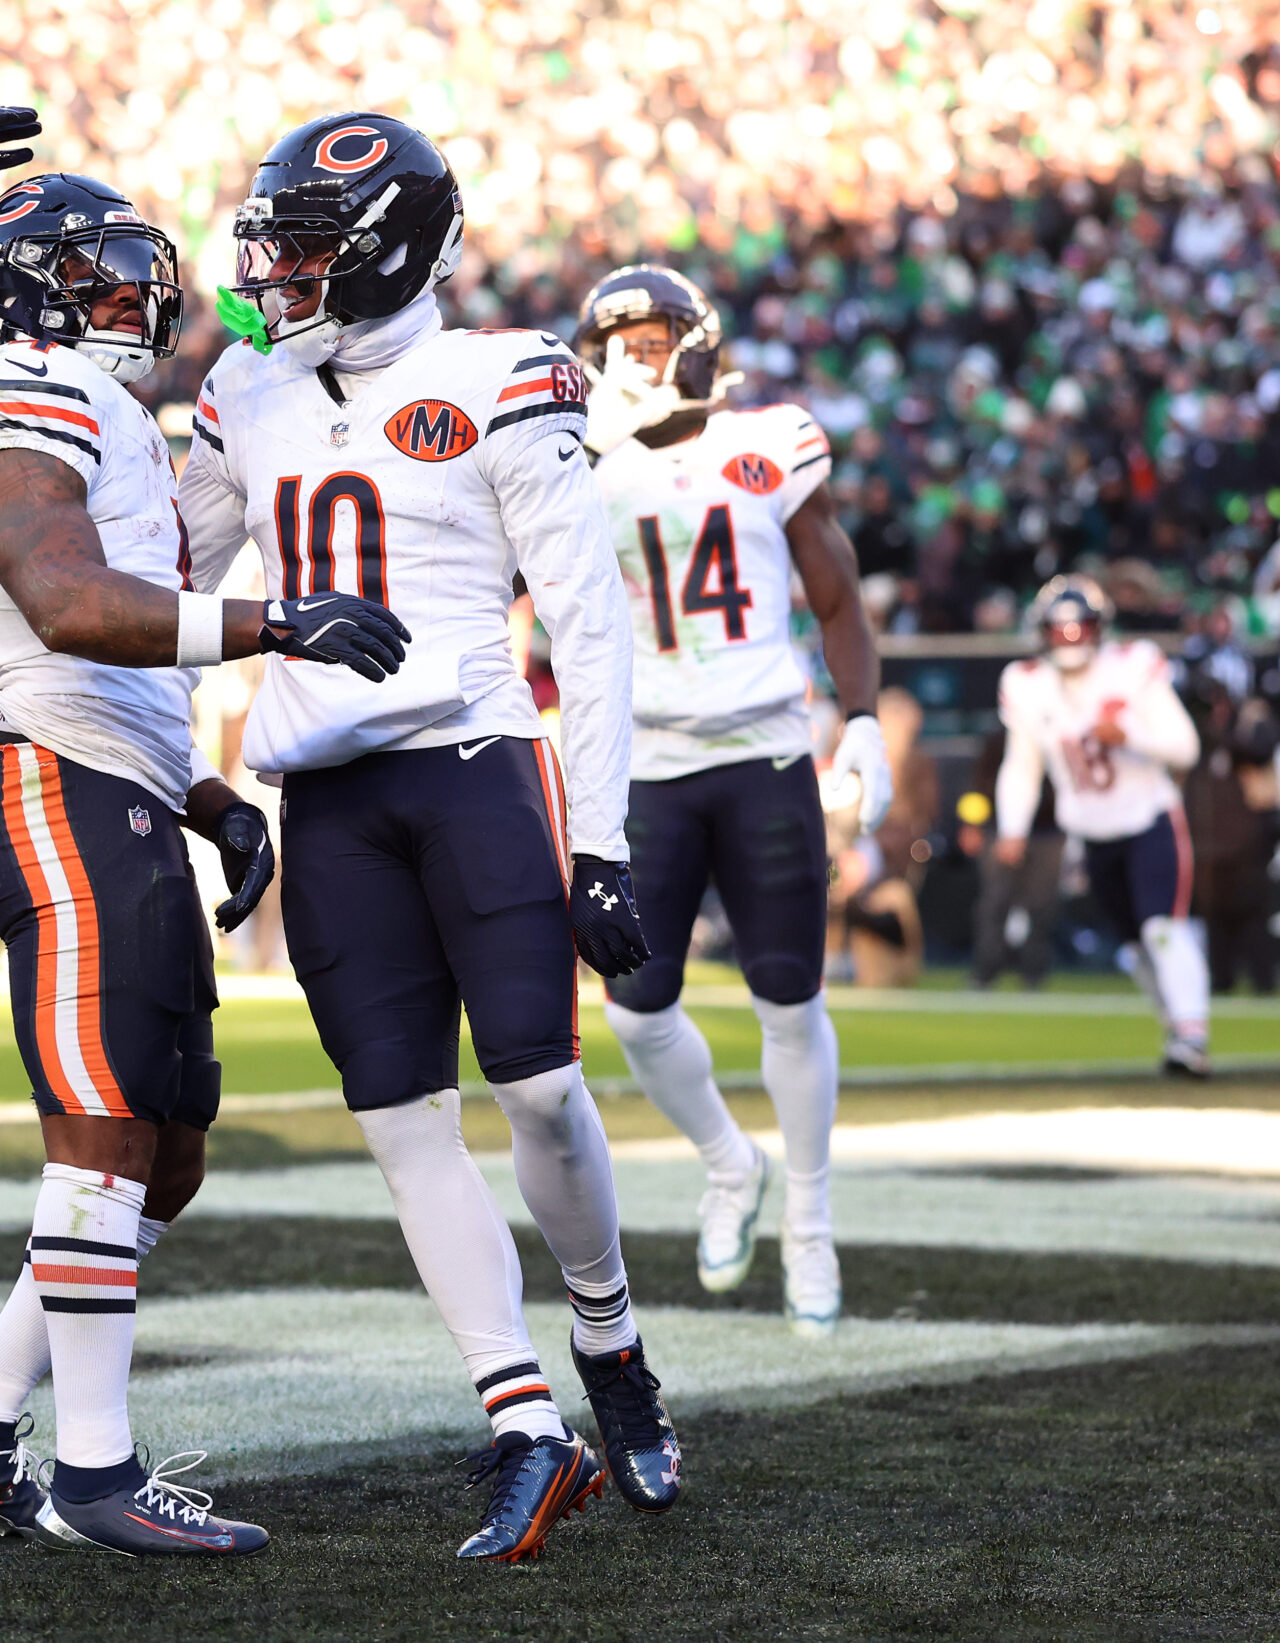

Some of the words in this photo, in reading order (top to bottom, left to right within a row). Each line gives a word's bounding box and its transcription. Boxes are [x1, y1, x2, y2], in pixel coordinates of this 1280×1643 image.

[312, 126, 389, 174] C
[396, 404, 468, 457] VMH
[274, 471, 389, 612] 10
[637, 503, 753, 653] 14
